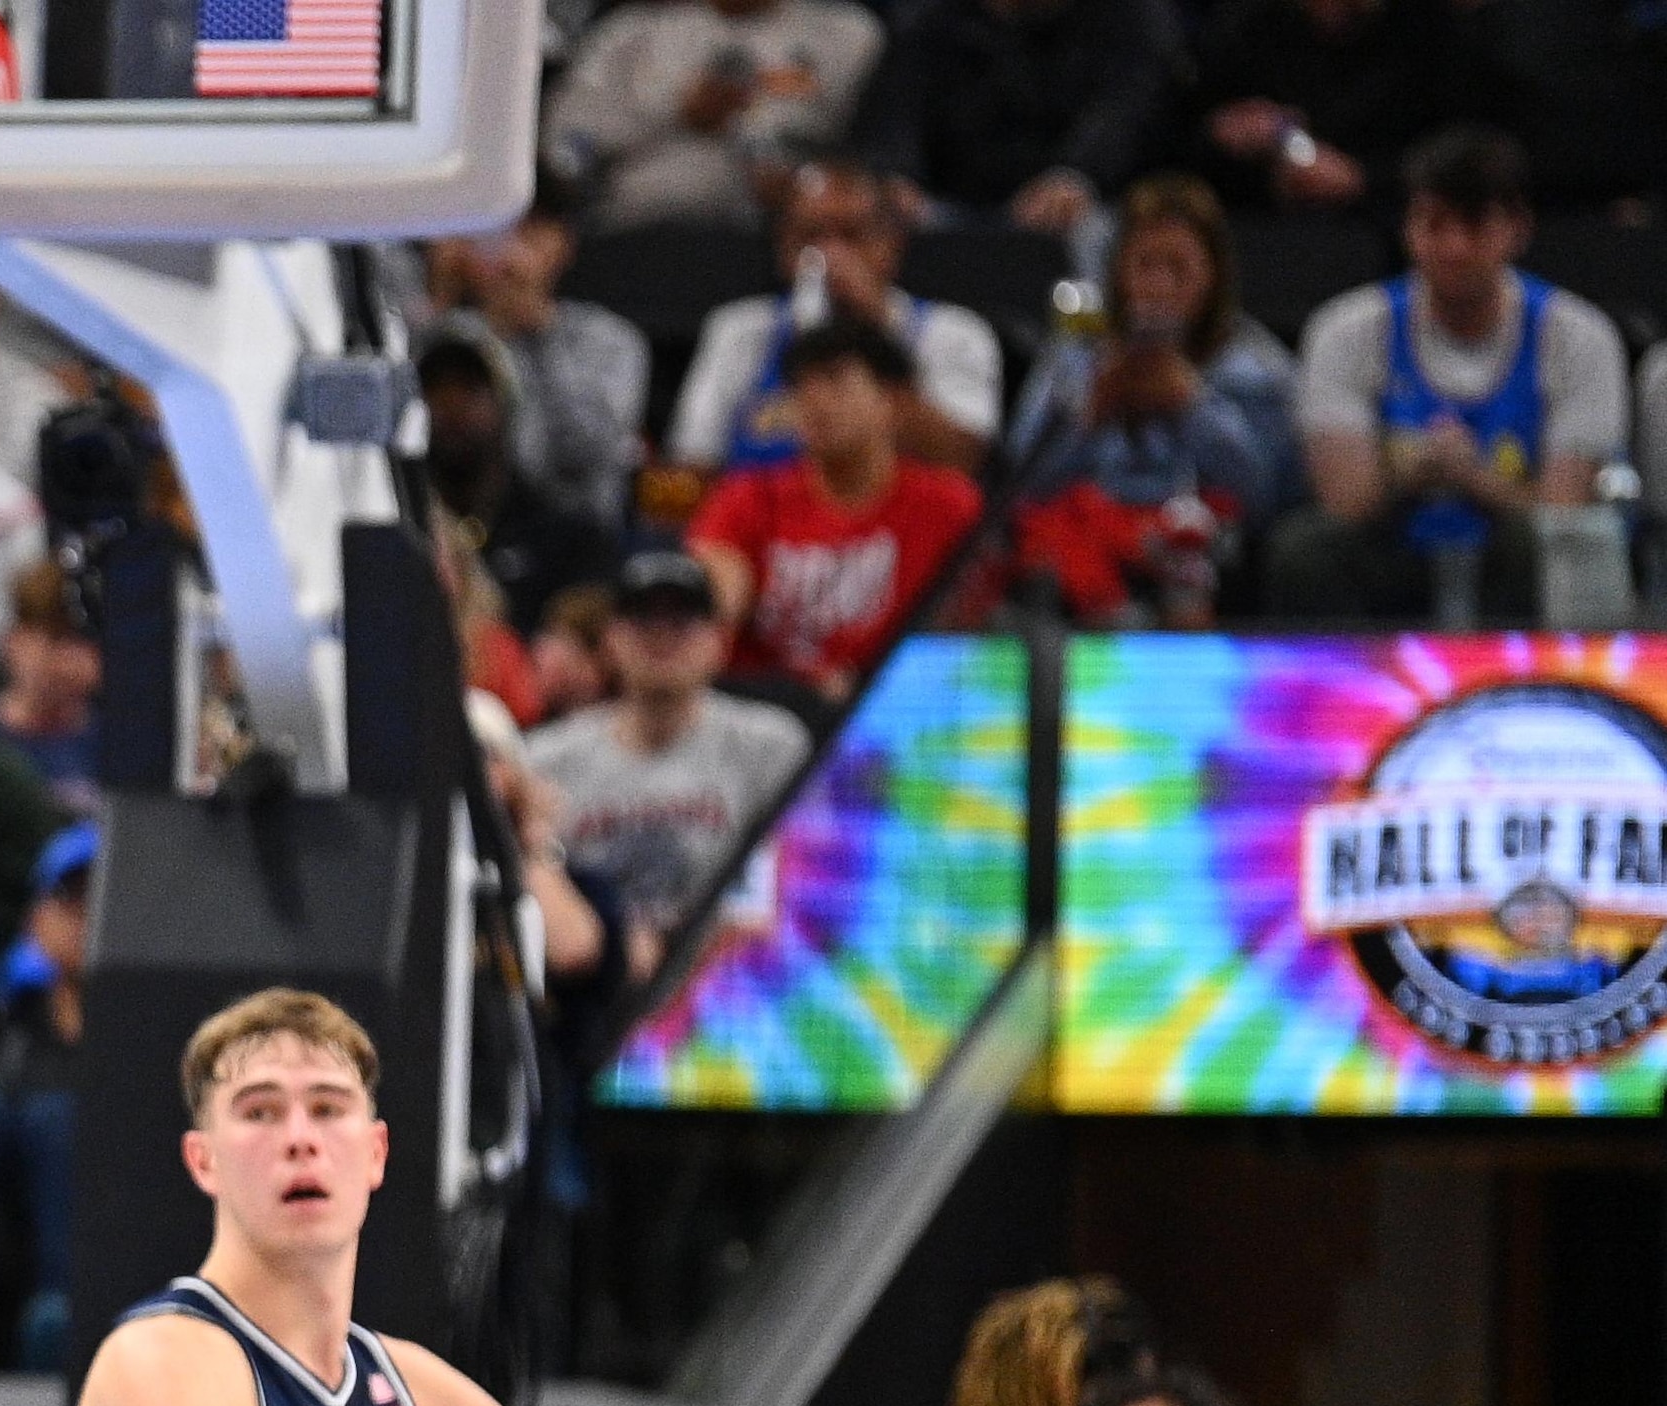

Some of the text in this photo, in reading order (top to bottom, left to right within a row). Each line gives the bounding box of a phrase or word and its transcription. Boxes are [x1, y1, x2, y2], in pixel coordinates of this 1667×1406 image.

[1327, 812, 1667, 898] HALL OF FA
